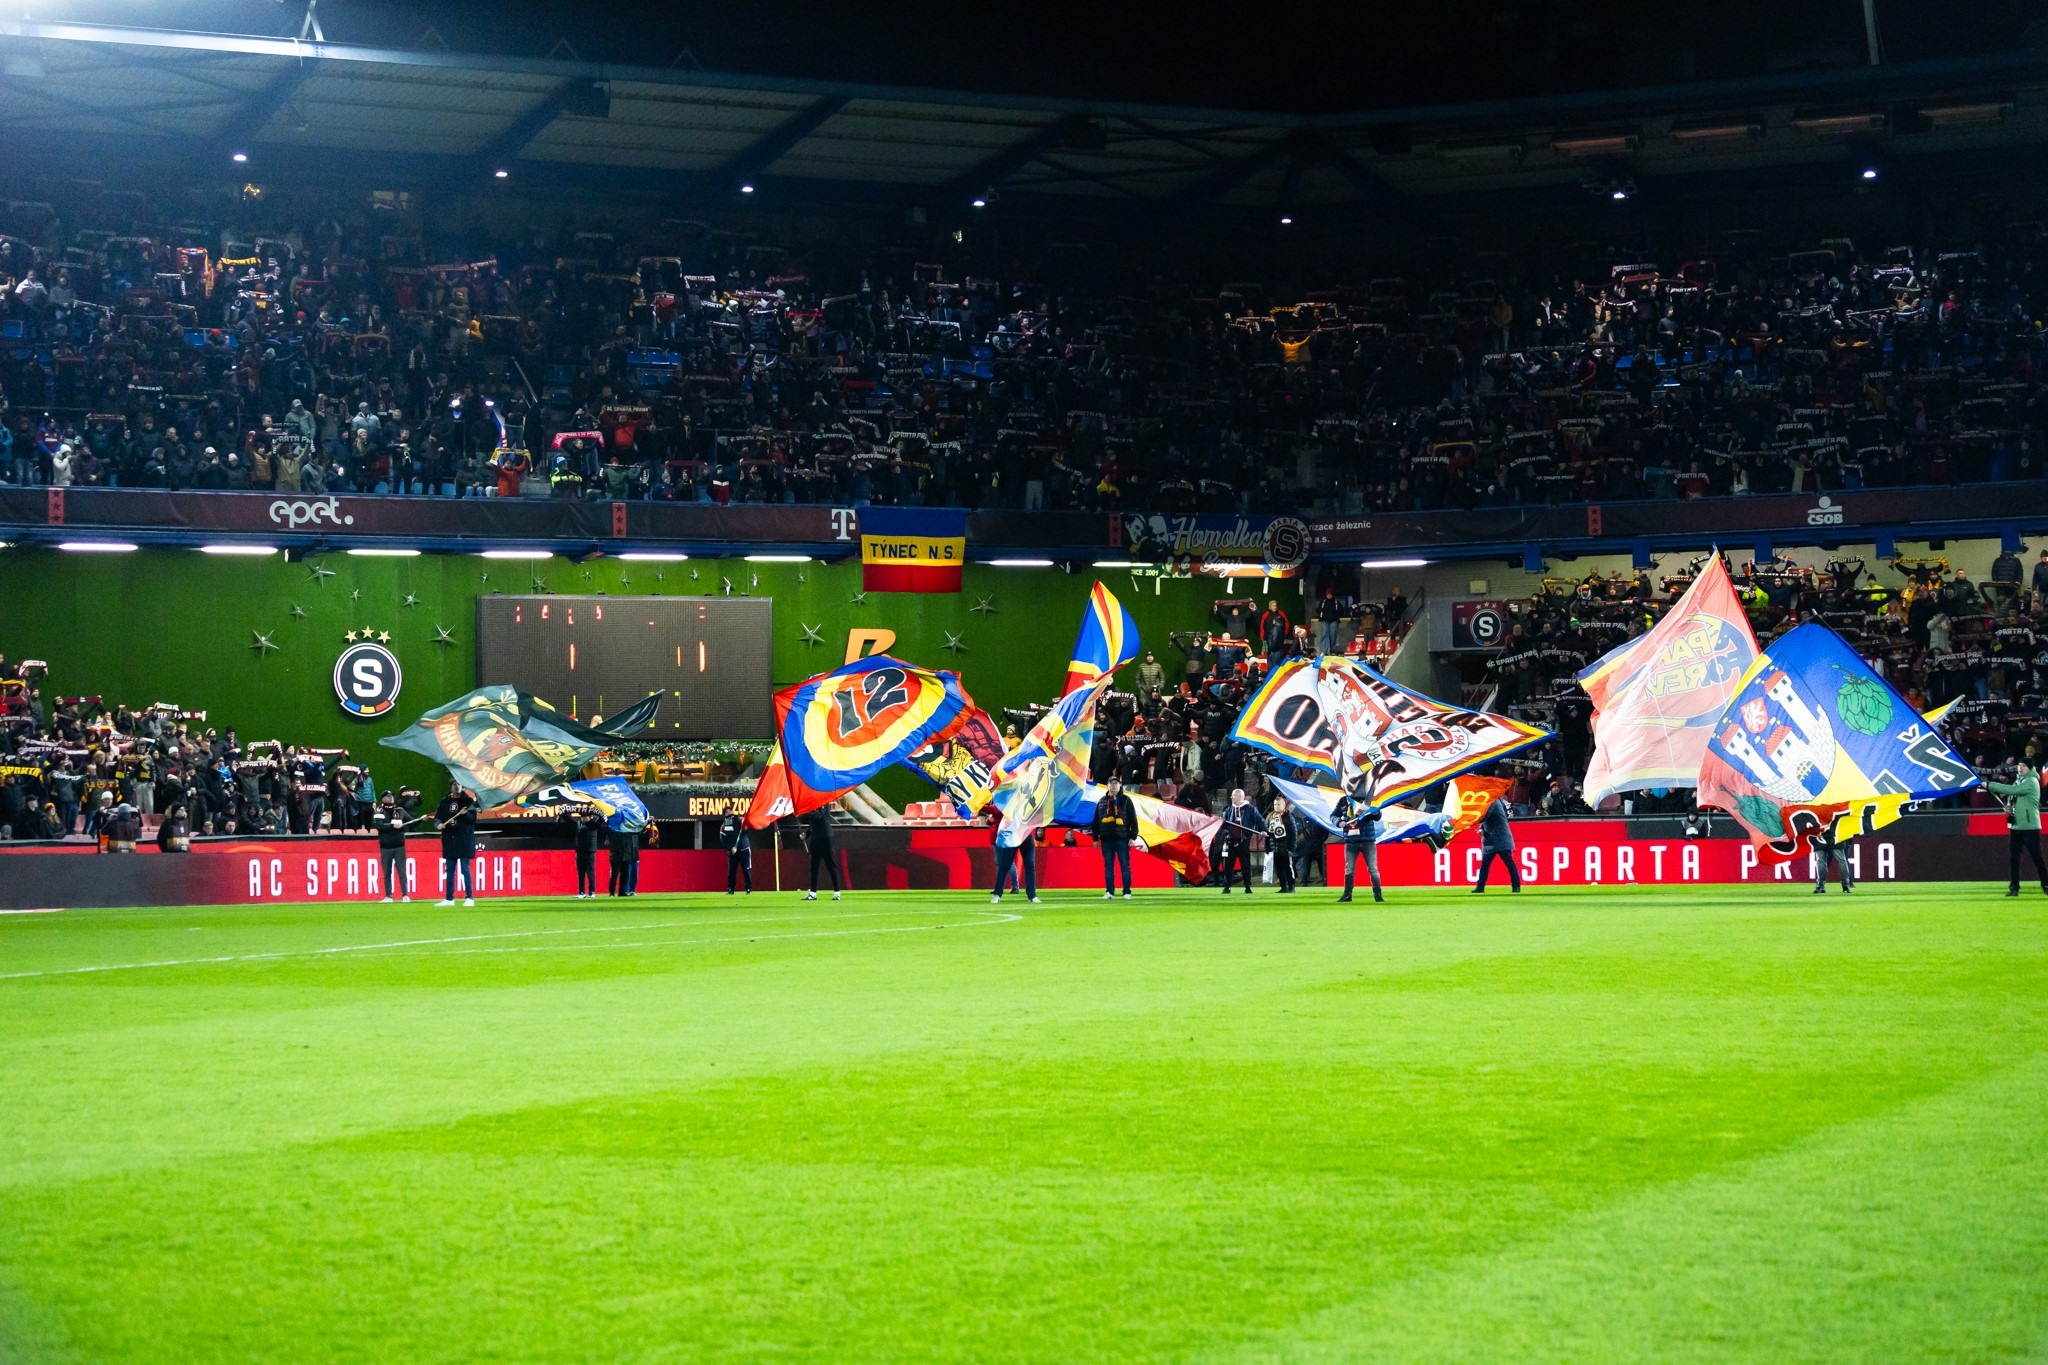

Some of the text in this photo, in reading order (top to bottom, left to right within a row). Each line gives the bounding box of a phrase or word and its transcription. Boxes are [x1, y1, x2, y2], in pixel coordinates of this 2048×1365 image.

[1172, 516, 1267, 549] Homolka
[1336, 521, 1371, 530] železnic
[1807, 514, 1843, 525] ČSOB
[870, 540, 917, 558] TÝNEC
[1200, 549, 1243, 578] Boys
[1479, 617, 1494, 636] S
[353, 659, 382, 697] S
[833, 667, 908, 738] 12
[732, 798, 752, 815] ZON
[249, 859, 282, 896] AC
[1434, 847, 1482, 882] AC
[1521, 844, 1700, 881] SPARTA
